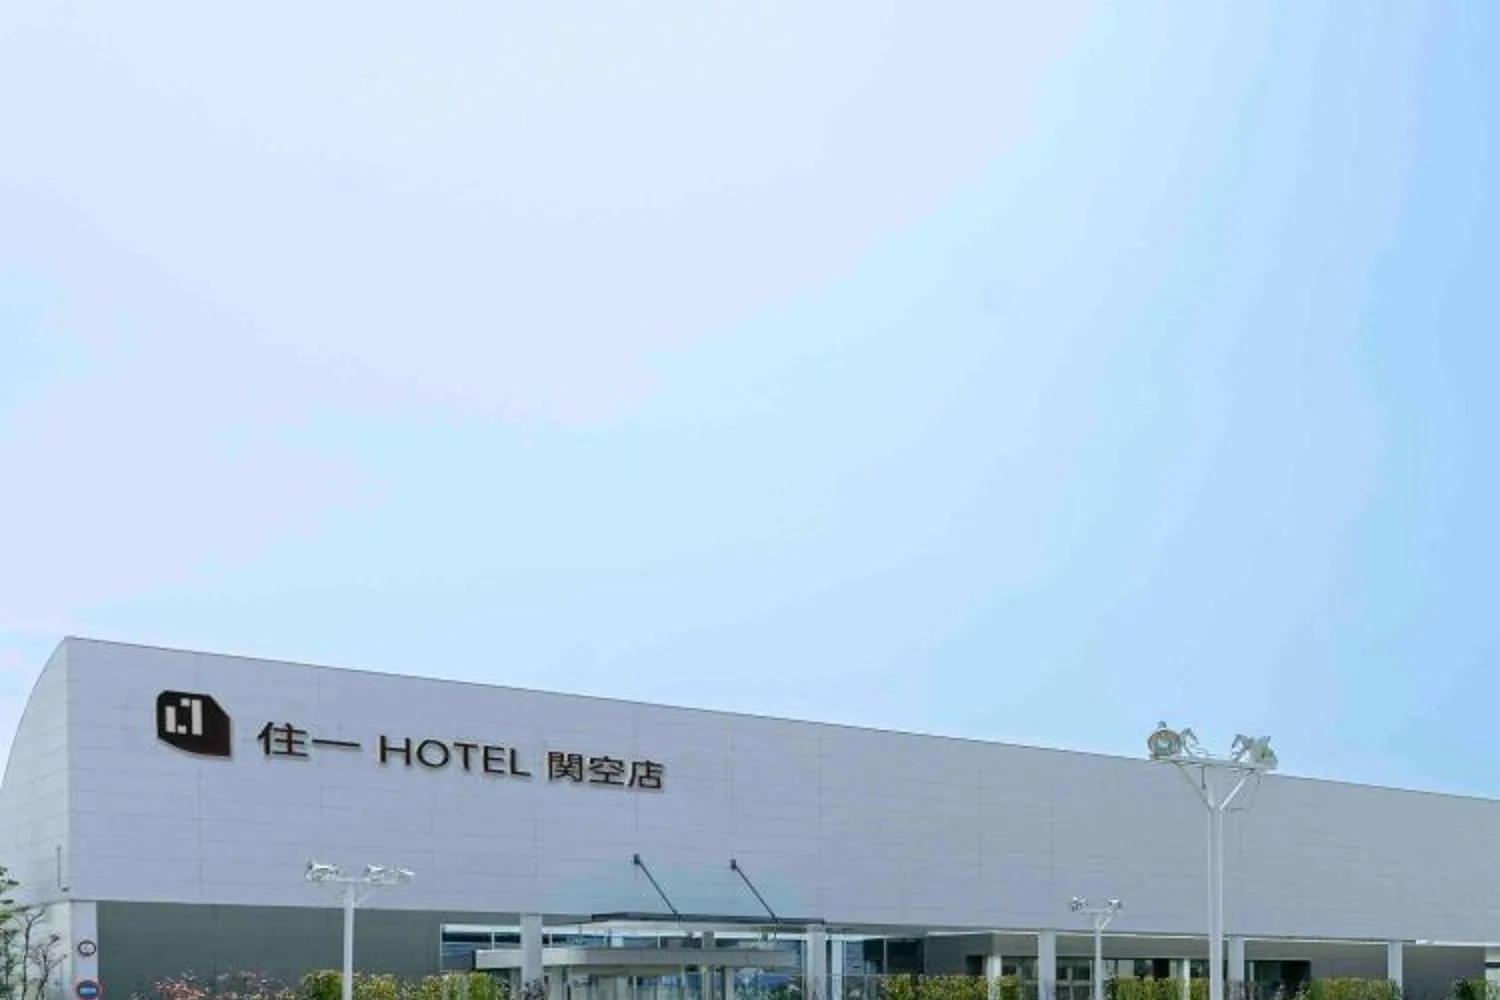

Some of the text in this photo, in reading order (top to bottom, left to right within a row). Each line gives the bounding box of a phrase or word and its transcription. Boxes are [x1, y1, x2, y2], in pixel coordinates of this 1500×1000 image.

[257, 721, 665, 790] 住一 HOTEL 関空店
